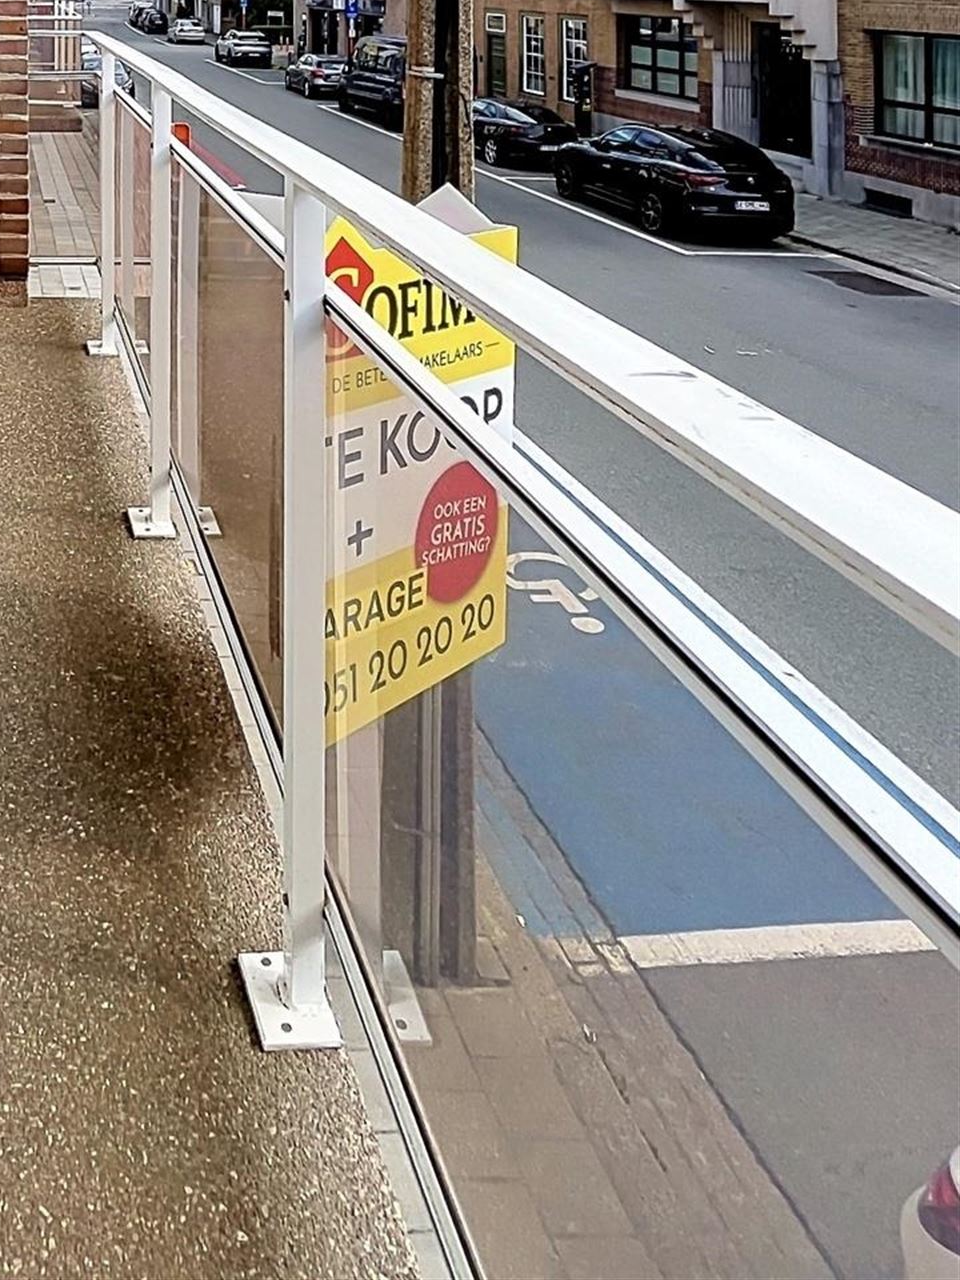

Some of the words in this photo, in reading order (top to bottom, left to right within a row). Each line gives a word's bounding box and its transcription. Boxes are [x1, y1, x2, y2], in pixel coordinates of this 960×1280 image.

[365, 278, 476, 340] OFIM
[332, 374, 351, 394] DE
[356, 367, 388, 389] BETE
[420, 341, 483, 369] AKELAARS
[325, 427, 365, 490] E
[431, 514, 486, 545] GRATIS
[434, 500, 461, 520] OOK
[463, 495, 486, 514] EEN
[422, 535, 491, 566] SCHATTING?
[325, 572, 425, 640] ARAGE
[368, 639, 408, 694] 20
[417, 616, 453, 668] 20
[461, 593, 495, 643] 20
